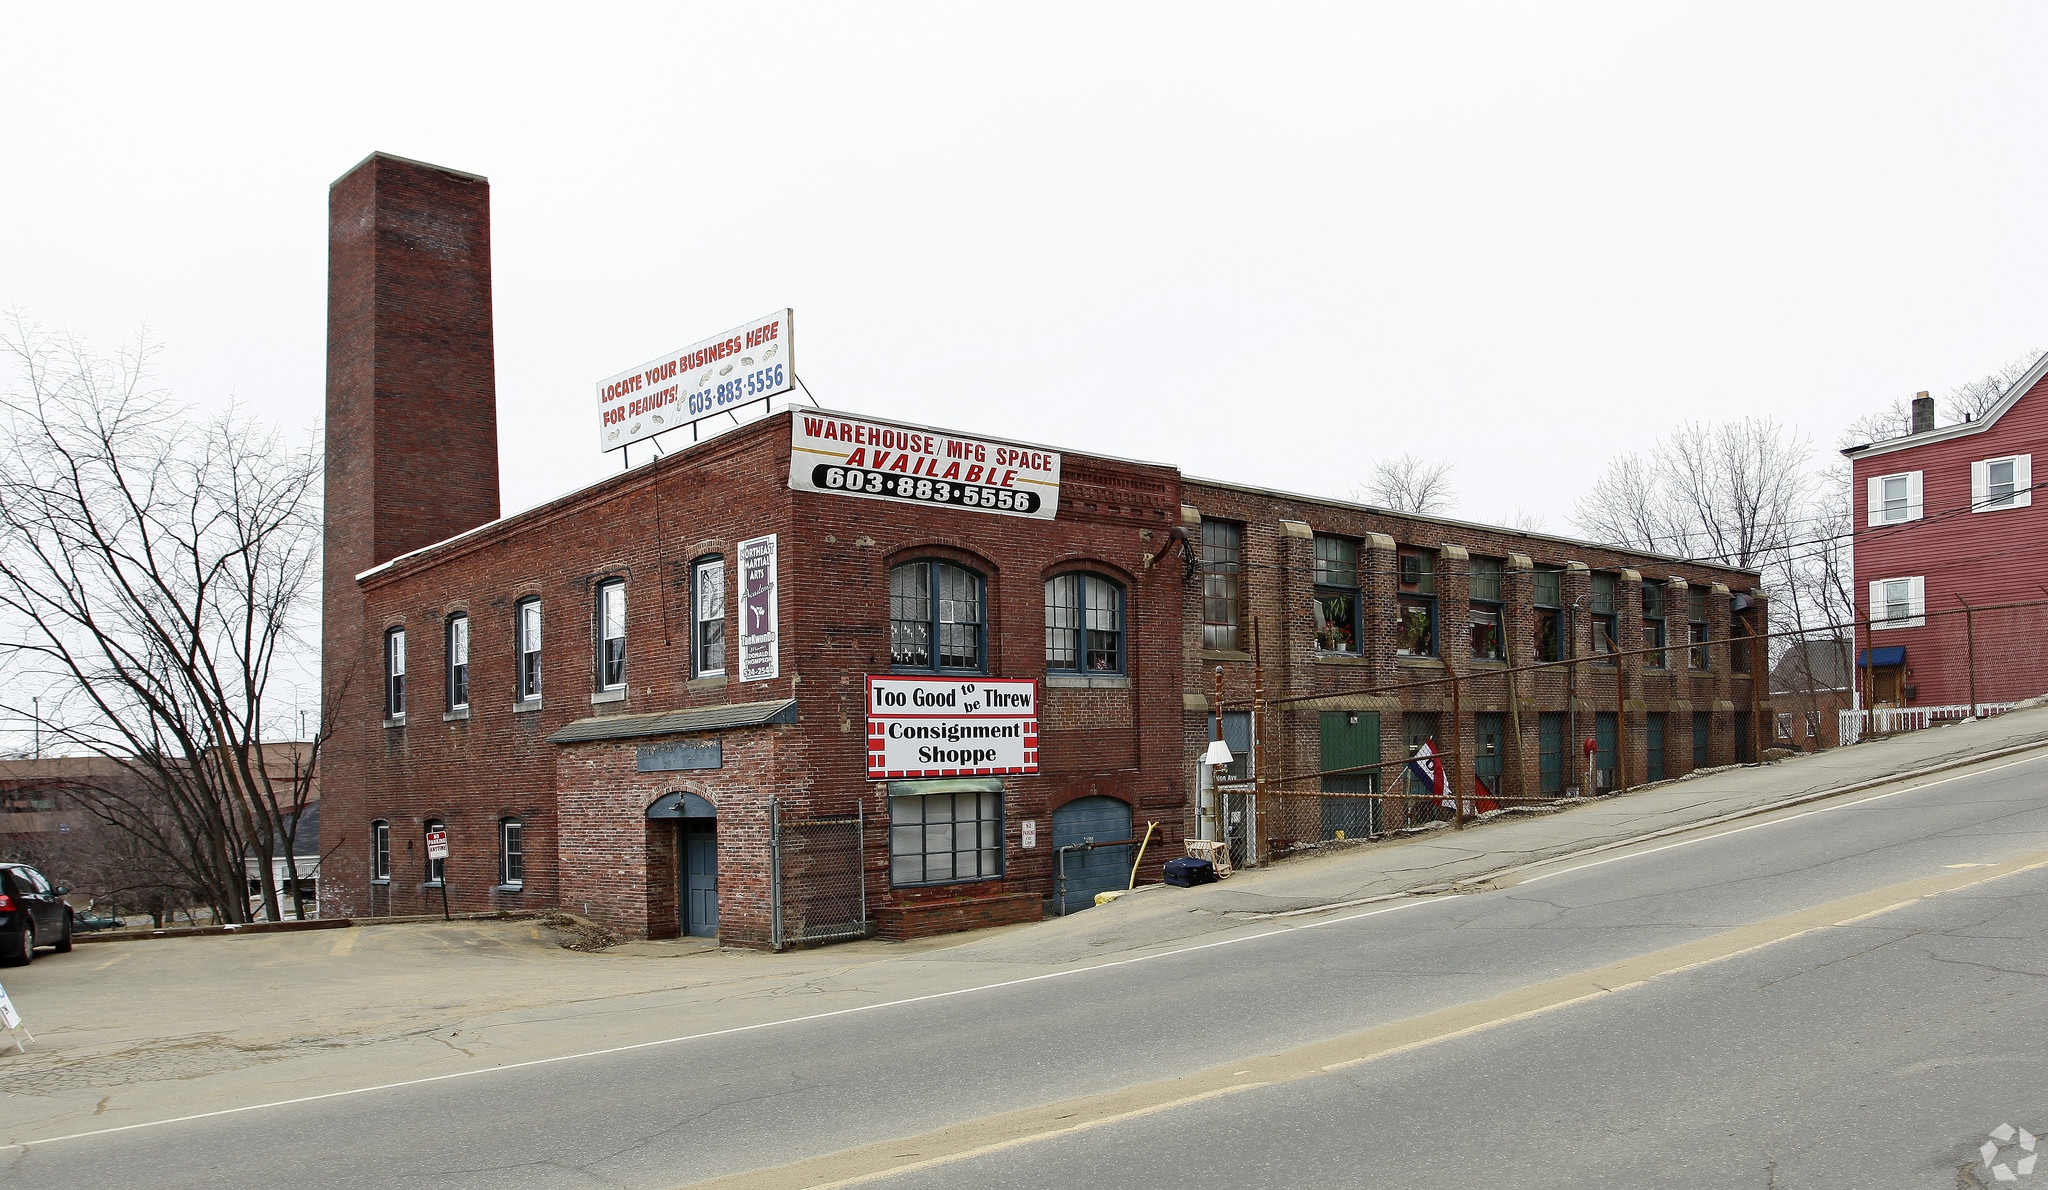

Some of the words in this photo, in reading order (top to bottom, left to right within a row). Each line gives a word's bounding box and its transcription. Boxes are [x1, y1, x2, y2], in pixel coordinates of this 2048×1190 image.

[601, 374, 642, 403] LOCATE
[645, 360, 677, 386] YOUR
[680, 335, 741, 373] BUSINESS
[746, 321, 779, 349] HERE
[603, 408, 626, 427] FOR
[629, 384, 678, 418] PEANUTS!
[845, 447, 1018, 488] AVAILABLE
[996, 447, 1053, 472] SPACE
[740, 543, 774, 561] NORTHEAST
[744, 555, 770, 570] MARTIAL
[749, 568, 765, 580] ARTS
[744, 656, 773, 667] THOMPSON
[873, 686, 907, 707] Too
[912, 687, 956, 707] Good
[960, 683, 976, 696] to
[983, 688, 1031, 707] Threw
[963, 700, 981, 713] be
[888, 722, 1020, 742] Consignment
[918, 746, 997, 765] Shoppe
